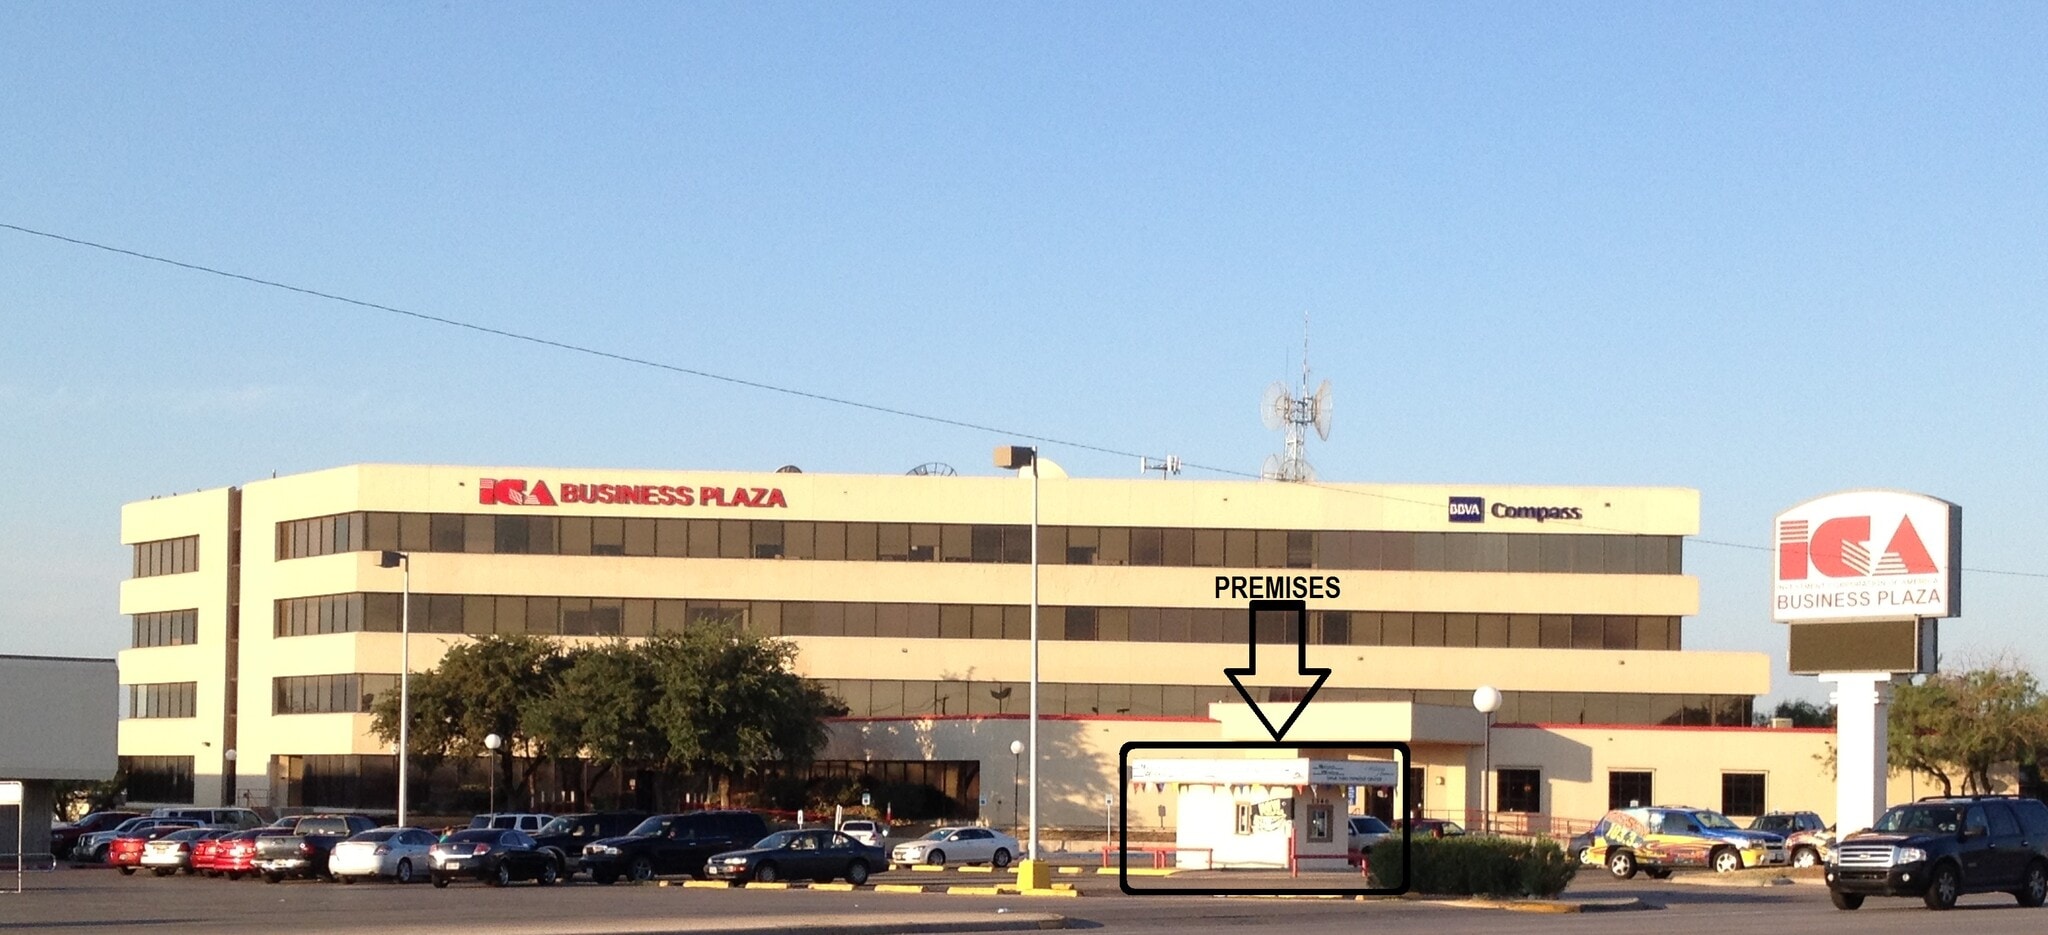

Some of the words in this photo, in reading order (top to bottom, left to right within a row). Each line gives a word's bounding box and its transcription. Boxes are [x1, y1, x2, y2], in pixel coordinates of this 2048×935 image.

[560, 483, 695, 506] BUSINESS
[699, 486, 788, 508] PLAZA
[1450, 503, 1480, 516] BBVA
[1491, 502, 1583, 523] Compass
[1777, 591, 1871, 610] BUSINESS
[1878, 588, 1941, 606] PLAZA
